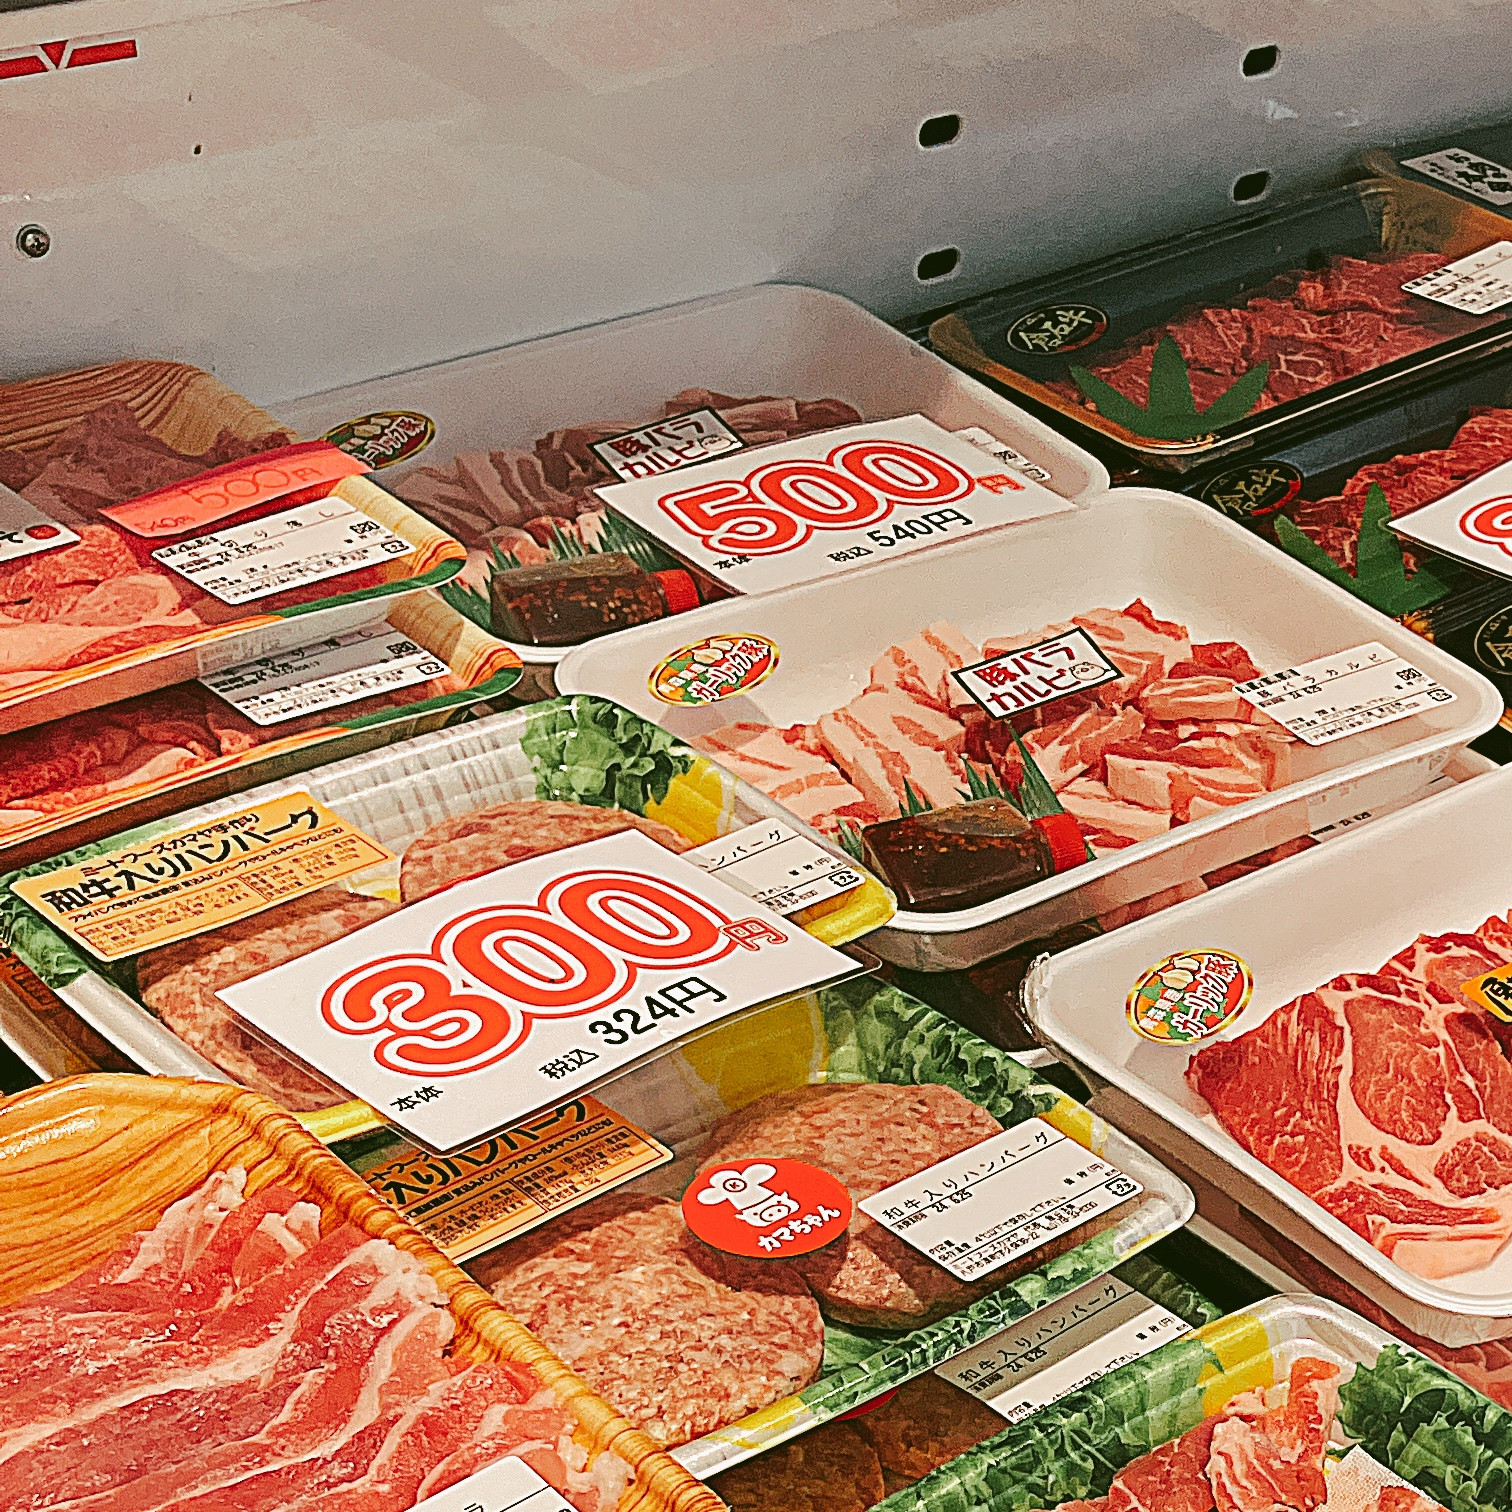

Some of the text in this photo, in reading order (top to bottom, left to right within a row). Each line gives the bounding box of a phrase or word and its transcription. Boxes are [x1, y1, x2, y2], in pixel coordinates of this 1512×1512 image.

[660, 439, 1025, 556] 500円
[712, 554, 752, 571] 本体
[827, 509, 972, 569] 税込 540円
[975, 643, 1077, 689] 豚バラ
[985, 666, 1069, 711] カルビ
[41, 807, 320, 912] 和牛入りハンバーグ
[322, 869, 789, 1076] 300円
[539, 977, 727, 1079] 税込 324円
[390, 1086, 443, 1111] 本体
[883, 1131, 1049, 1223] 和牛入りハンバーグ
[757, 1204, 842, 1252] カマちゃん
[958, 1284, 1118, 1383] 和牛入りハンバーグ
